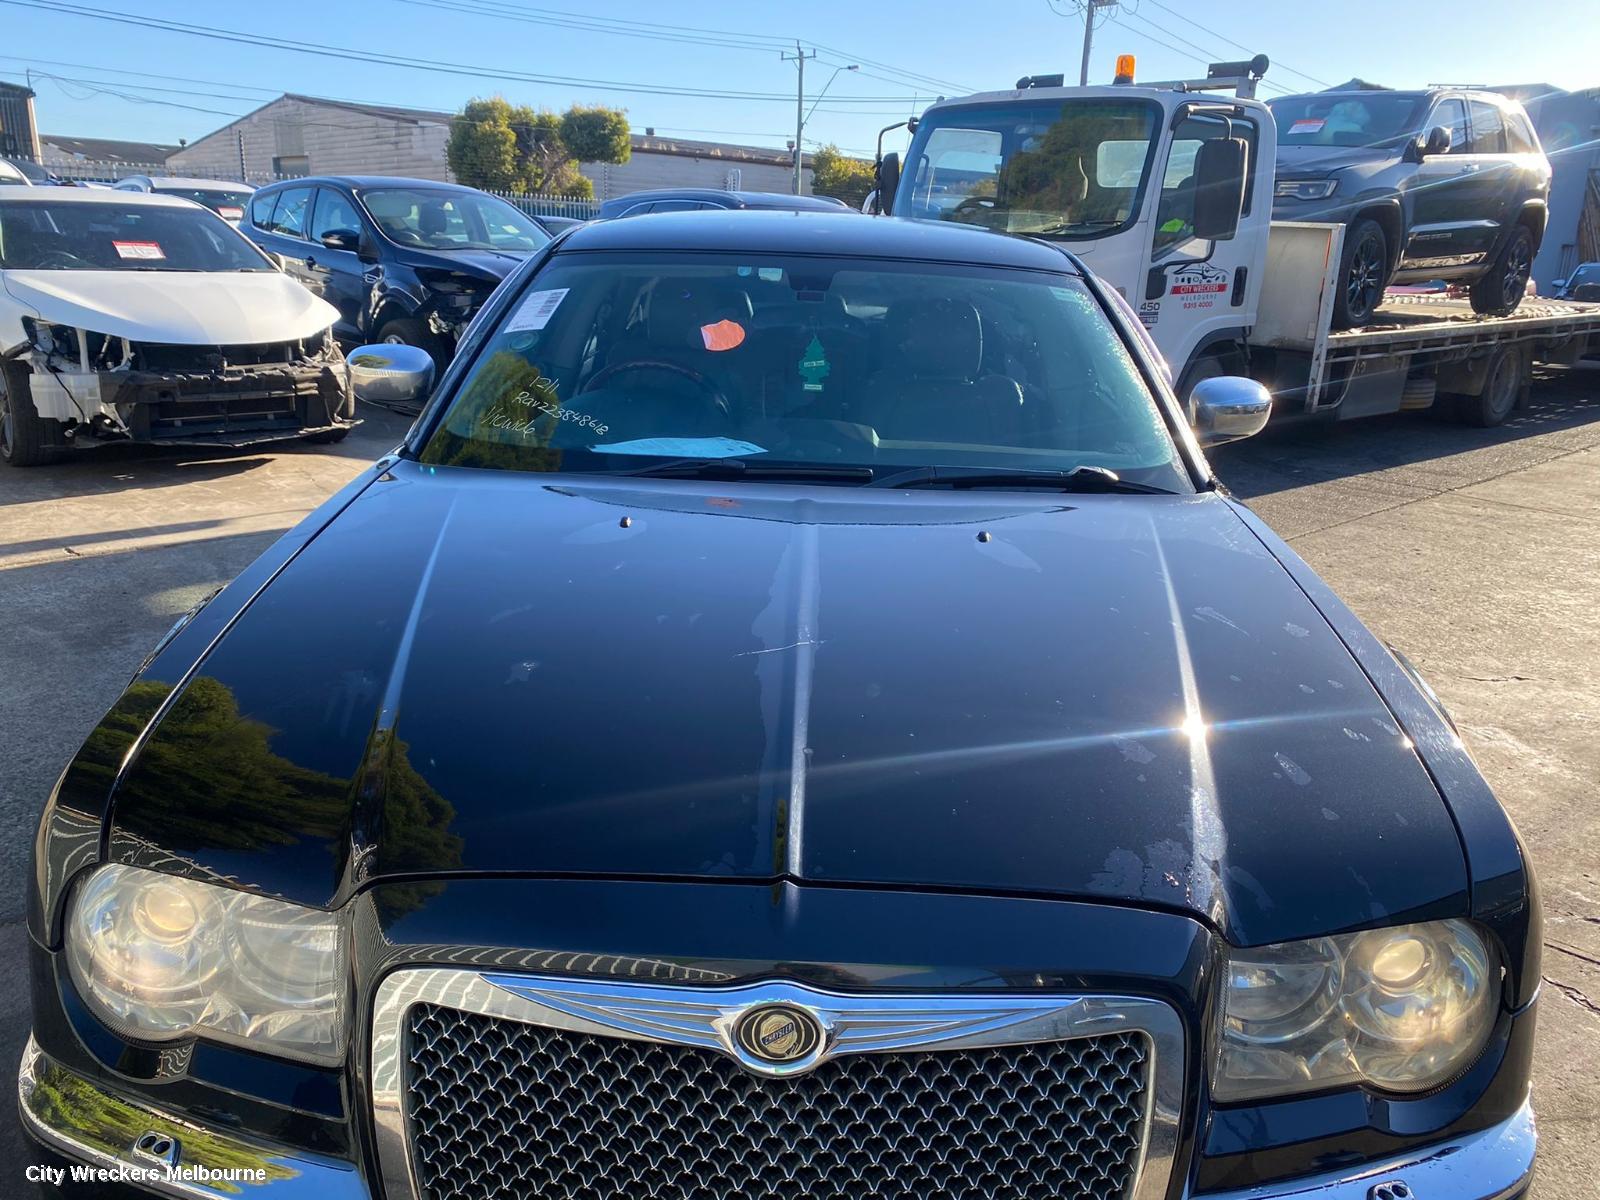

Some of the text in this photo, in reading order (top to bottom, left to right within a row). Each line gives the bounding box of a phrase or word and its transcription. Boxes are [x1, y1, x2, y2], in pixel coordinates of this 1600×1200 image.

[1180, 284, 1219, 294] CITY WRECKERS
[1140, 302, 1160, 311] 450
[764, 1023, 793, 1045] CHRYSLER
